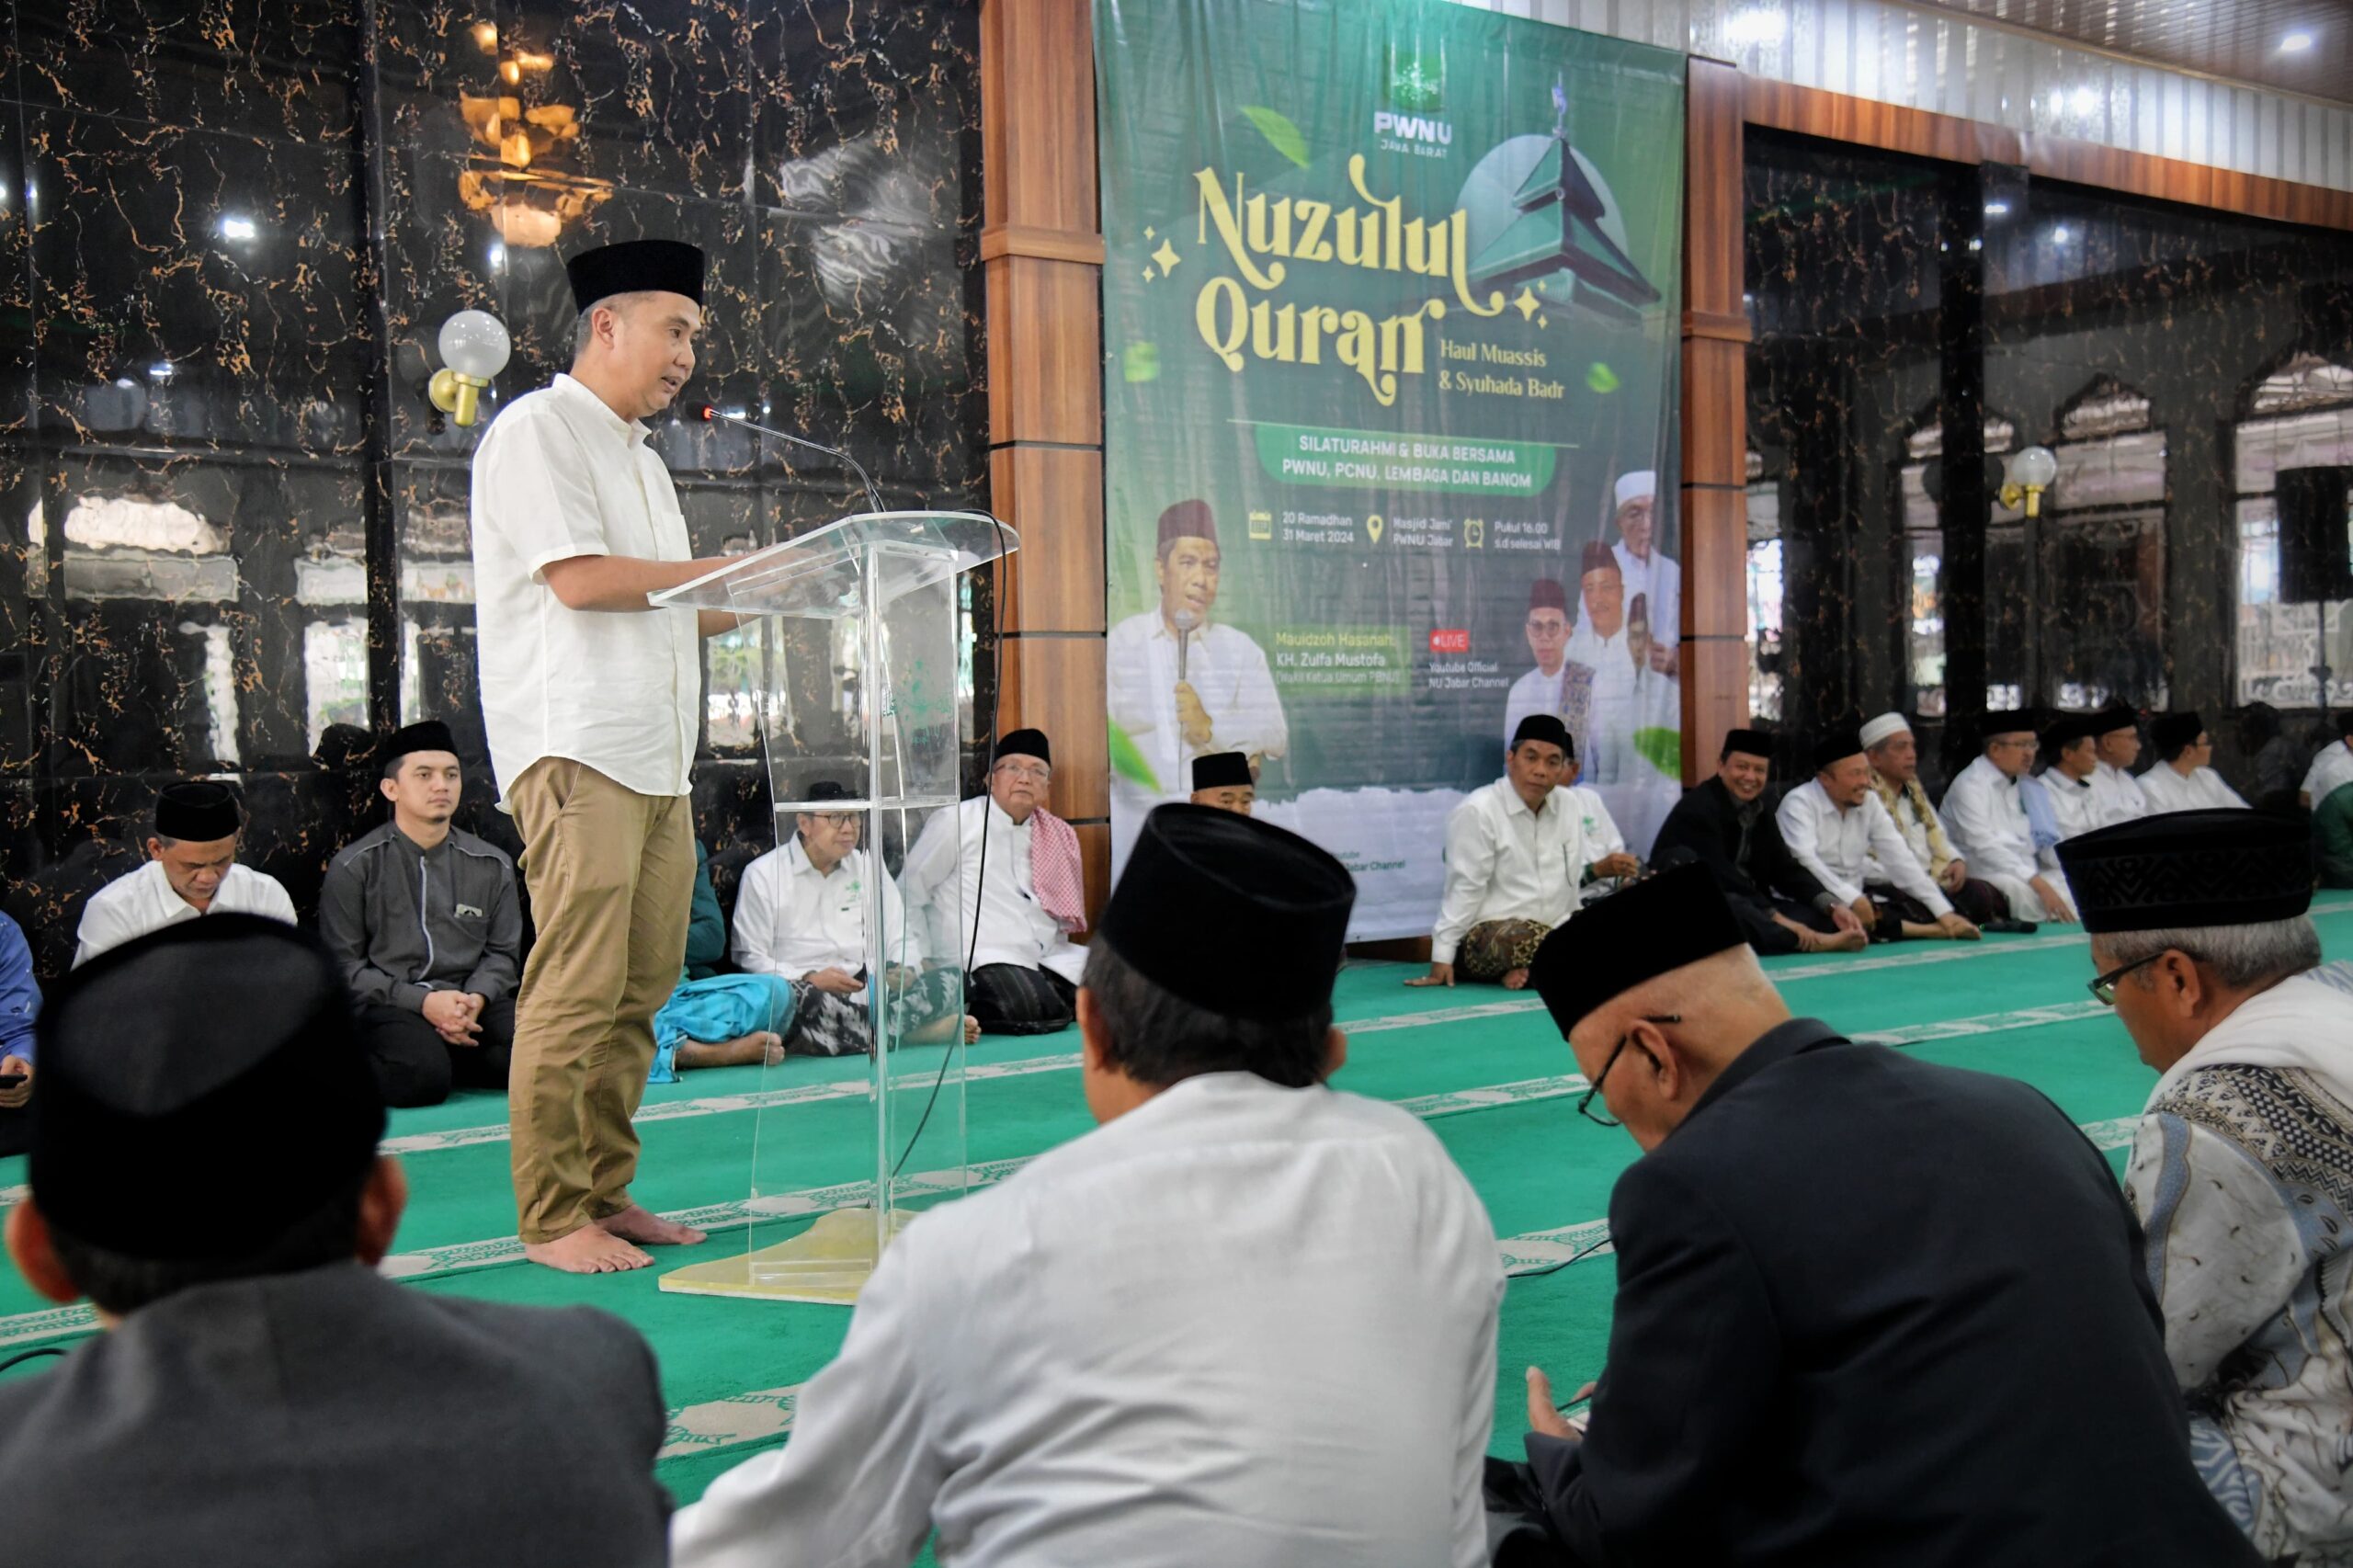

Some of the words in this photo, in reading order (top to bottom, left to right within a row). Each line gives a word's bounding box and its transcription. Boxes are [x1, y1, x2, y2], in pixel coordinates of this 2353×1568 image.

[1374, 111, 1452, 144] PWNU
[1381, 139, 1410, 153] JAWA
[1415, 144, 1448, 159] BARAT
[1193, 153, 1505, 316] Nuzulul
[1196, 277, 1446, 406] Quran
[1440, 338, 1476, 360] Haul
[1482, 343, 1546, 368] Muassis
[1439, 369, 1451, 390] &
[1456, 371, 1523, 396] Syuhada
[1529, 378, 1564, 399] Badr
[1300, 435, 1395, 457] SILATURAHMI
[1399, 442, 1408, 458] &
[1414, 443, 1449, 460] BUKA
[1452, 445, 1515, 464] BERSAMA
[1282, 459, 1330, 478] PWNU,
[1336, 463, 1381, 481] PCNU,
[1385, 466, 1449, 483] LEMBAGA
[1452, 469, 1480, 485] DAN
[1483, 471, 1531, 487] BANOM
[1282, 511, 1295, 524] 20
[1298, 512, 1353, 527] Ramadhan
[1392, 517, 1427, 532] Masjid
[1495, 520, 1520, 533] Pukul
[1522, 521, 1548, 535] 16.00
[1282, 528, 1293, 541] 31
[1296, 528, 1324, 542] Maret
[1327, 530, 1354, 543] 2024
[1392, 533, 1425, 546] PWNU
[1427, 533, 1453, 547] Jabar
[1510, 539, 1541, 551] selesai
[1544, 539, 1561, 551] WIB
[1276, 631, 1335, 646] Mauidzoh
[1440, 633, 1465, 648] LIVE
[1276, 653, 1298, 667] KH.
[1301, 653, 1332, 667] Zulfa
[1336, 653, 1386, 667] Mustofa
[1429, 662, 1465, 673] Youtube
[1467, 661, 1498, 673] Official
[1428, 677, 1442, 688] NU
[1444, 677, 1470, 688] Jabar
[1472, 676, 1509, 688] Channel
[1370, 859, 1406, 871] Channel
